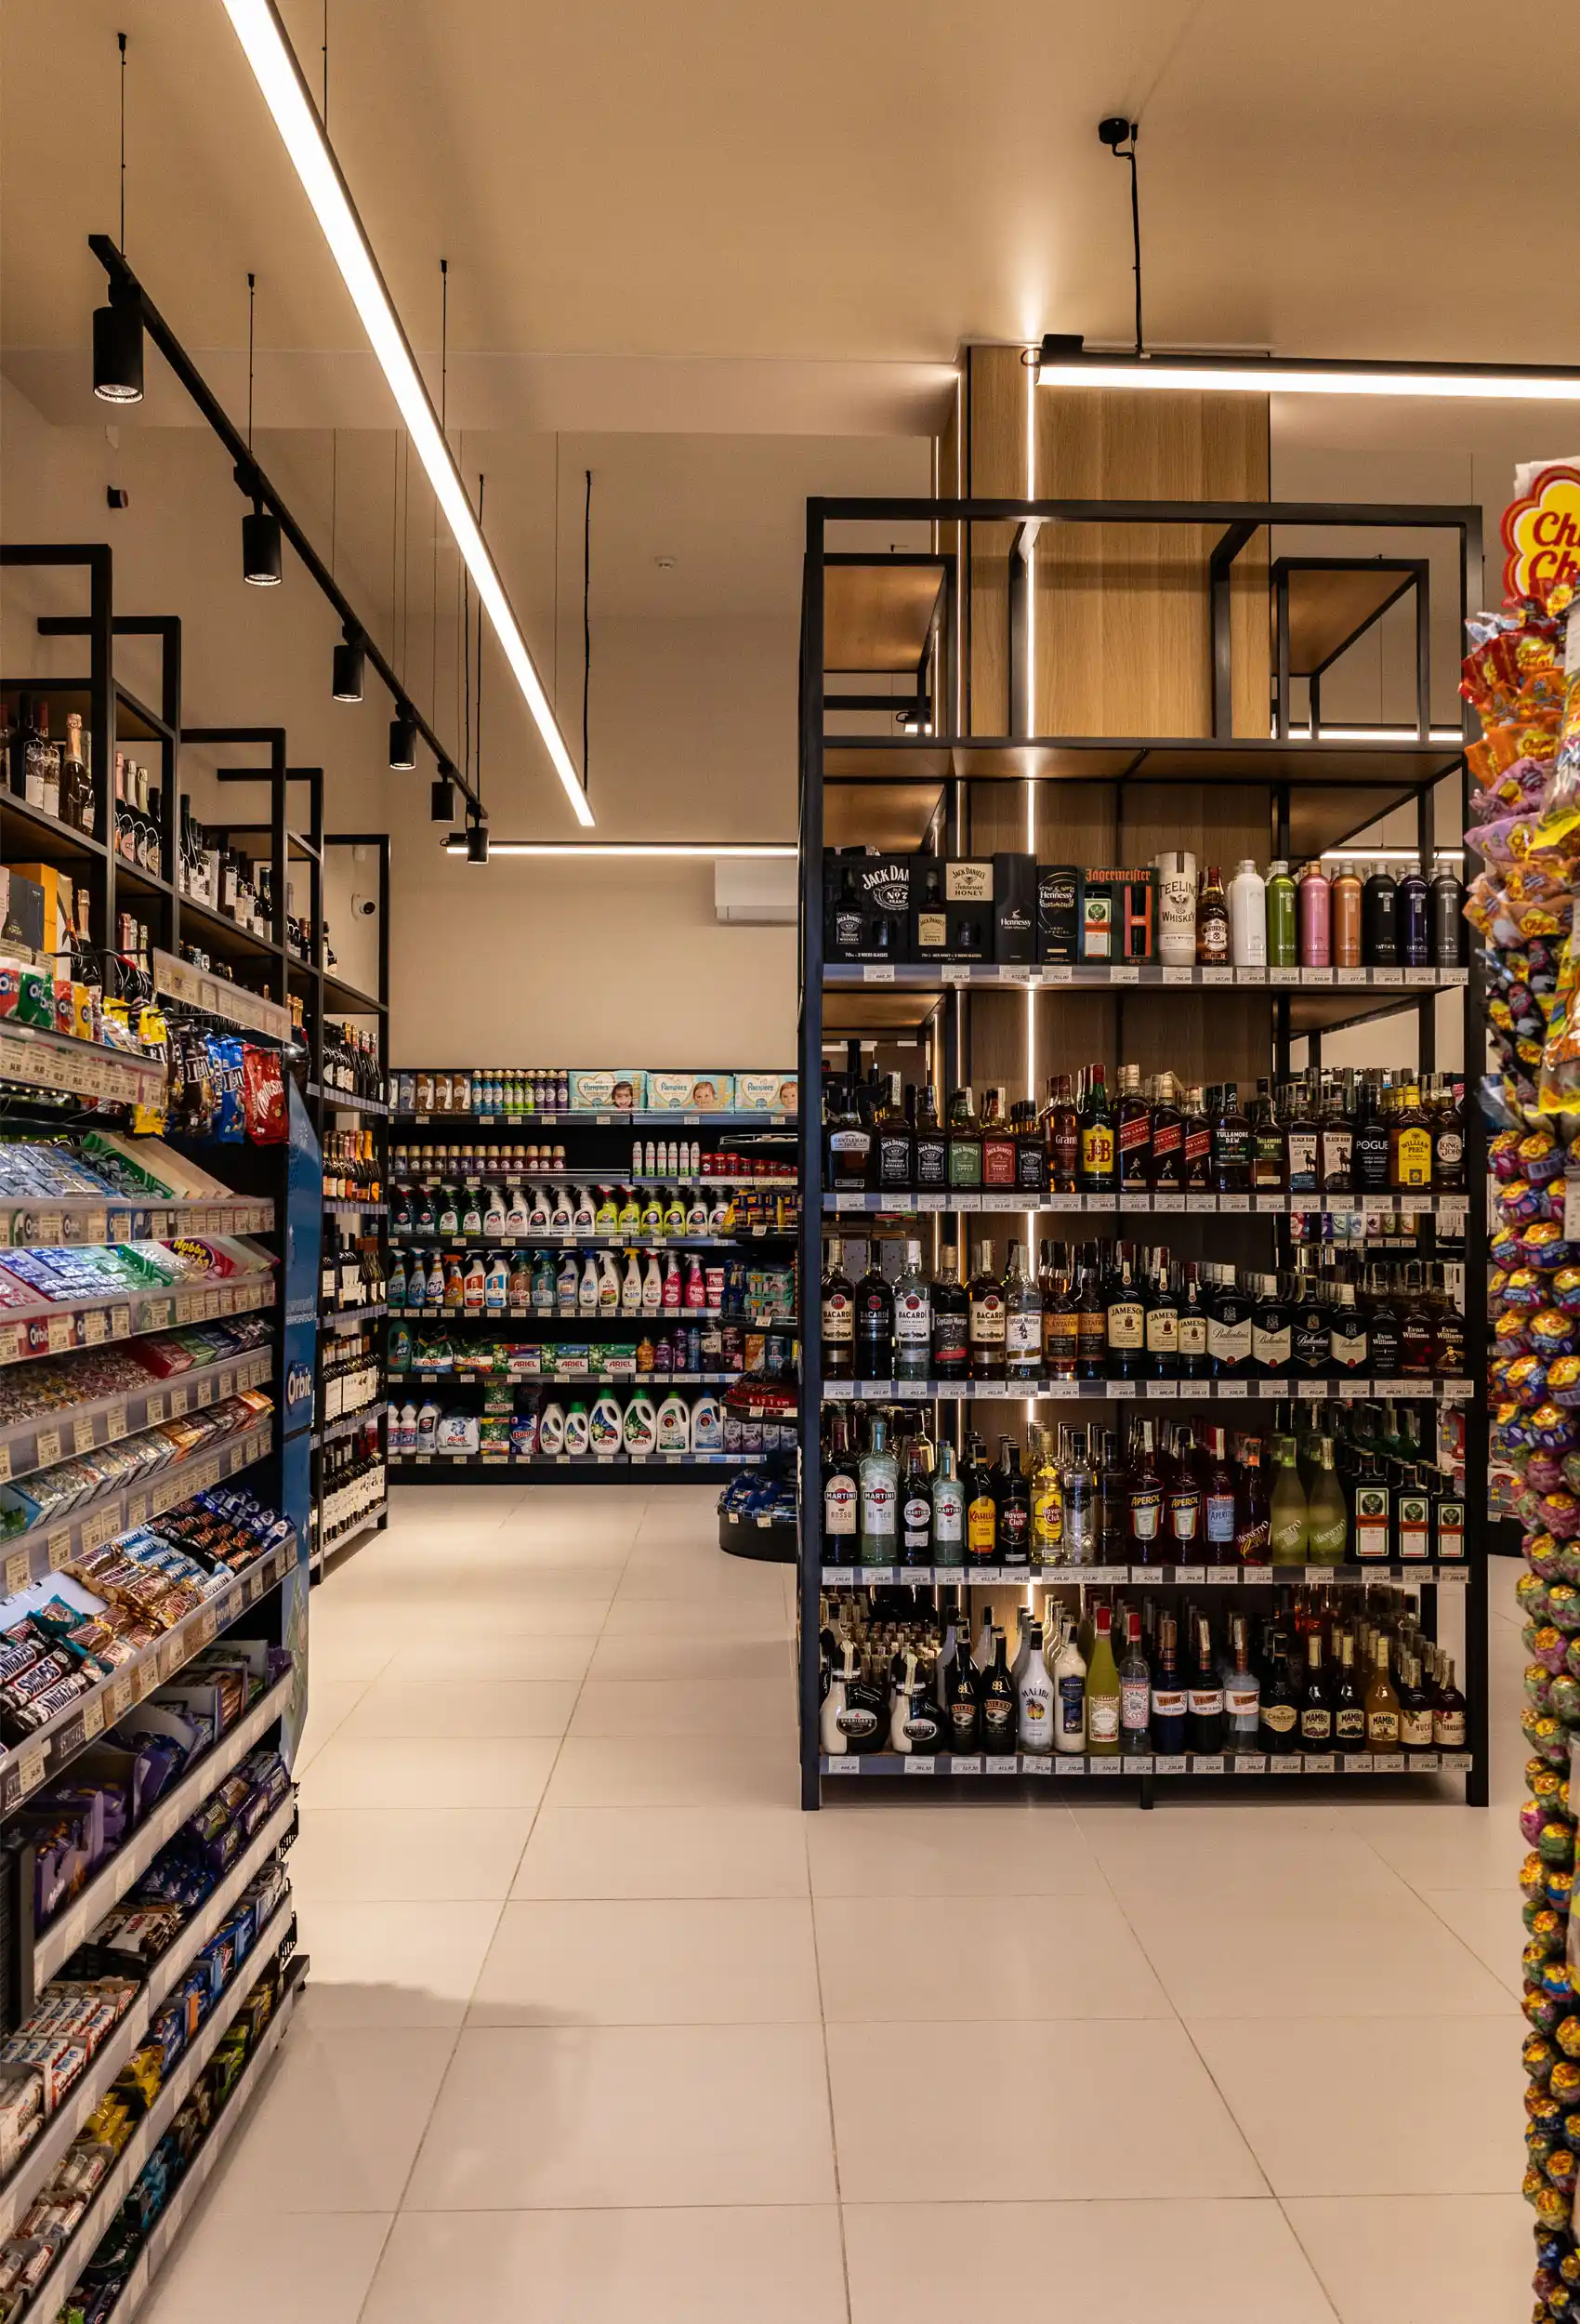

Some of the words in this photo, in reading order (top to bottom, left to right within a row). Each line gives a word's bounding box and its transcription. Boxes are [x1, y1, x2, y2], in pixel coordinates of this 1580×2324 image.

[1533, 511, 1580, 547] Ch
[862, 868, 888, 890] JACK
[952, 869, 966, 879] JACK
[1040, 891, 1073, 901] Hennessy
[1162, 912, 1195, 923] WHISKEY
[1000, 918, 1032, 928] Hennessy
[584, 1084, 609, 1092] Pampers
[661, 1082, 688, 1091] Pampers
[747, 1083, 774, 1092] Pampers
[881, 1140, 892, 1150] JACK
[918, 1144, 928, 1154] JACK
[1356, 1141, 1389, 1150] POGUE
[1402, 1141, 1429, 1149] WILLIAM
[1440, 1141, 1458, 1151] LONG
[952, 1146, 962, 1155] JACK
[986, 1147, 997, 1155] JACK
[174, 1238, 207, 1257] Hubba
[1150, 1312, 1178, 1322] JAMES
[288, 1367, 312, 1406] Orbit
[1131, 1495, 1160, 1507] APEROL
[1171, 1497, 1198, 1509] APEROL
[1022, 1688, 1051, 1700] MALIBU
[1306, 1713, 1327, 1723] MAMBO
[1341, 1713, 1363, 1723] MAMBO
[1373, 1716, 1395, 1725] MAMBO
